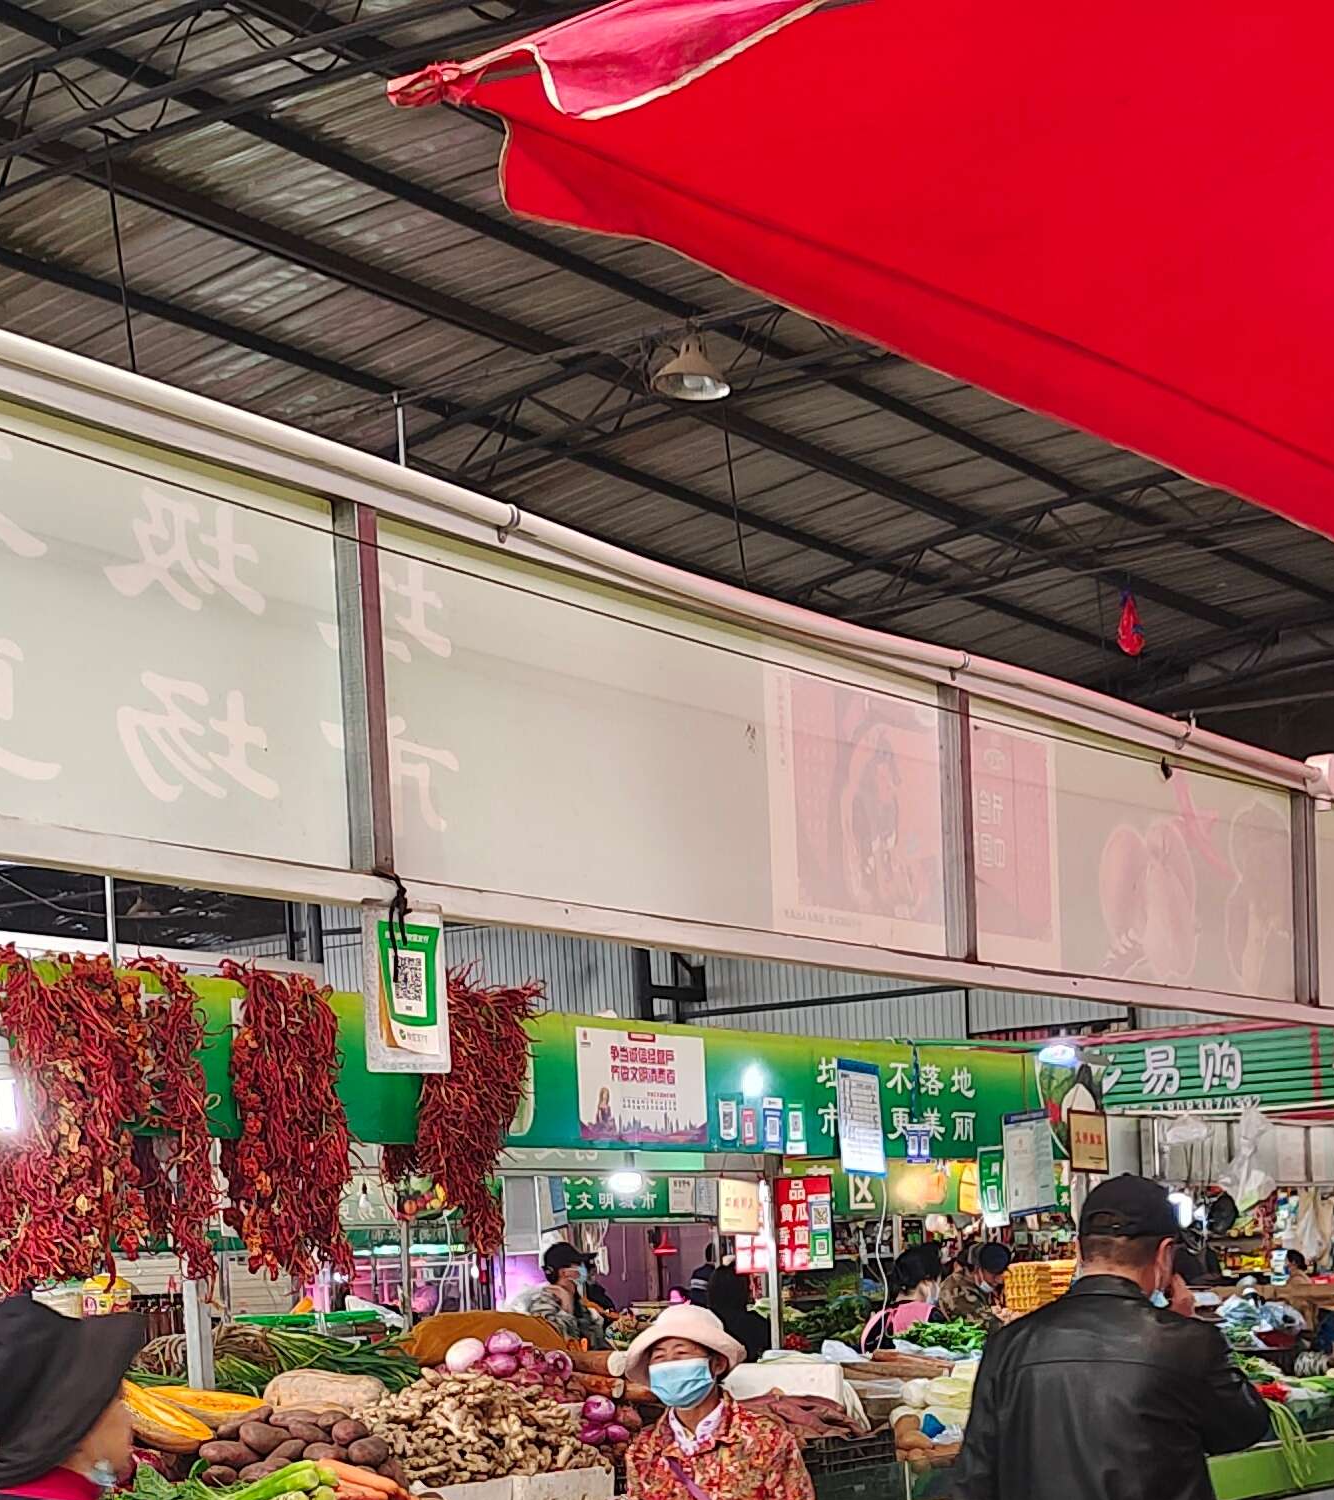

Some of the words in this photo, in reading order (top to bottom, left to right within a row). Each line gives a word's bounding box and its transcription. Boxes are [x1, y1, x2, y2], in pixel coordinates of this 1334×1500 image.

[816, 1056, 976, 1098] 垃不落地
[817, 1102, 977, 1142] 市更美丽
